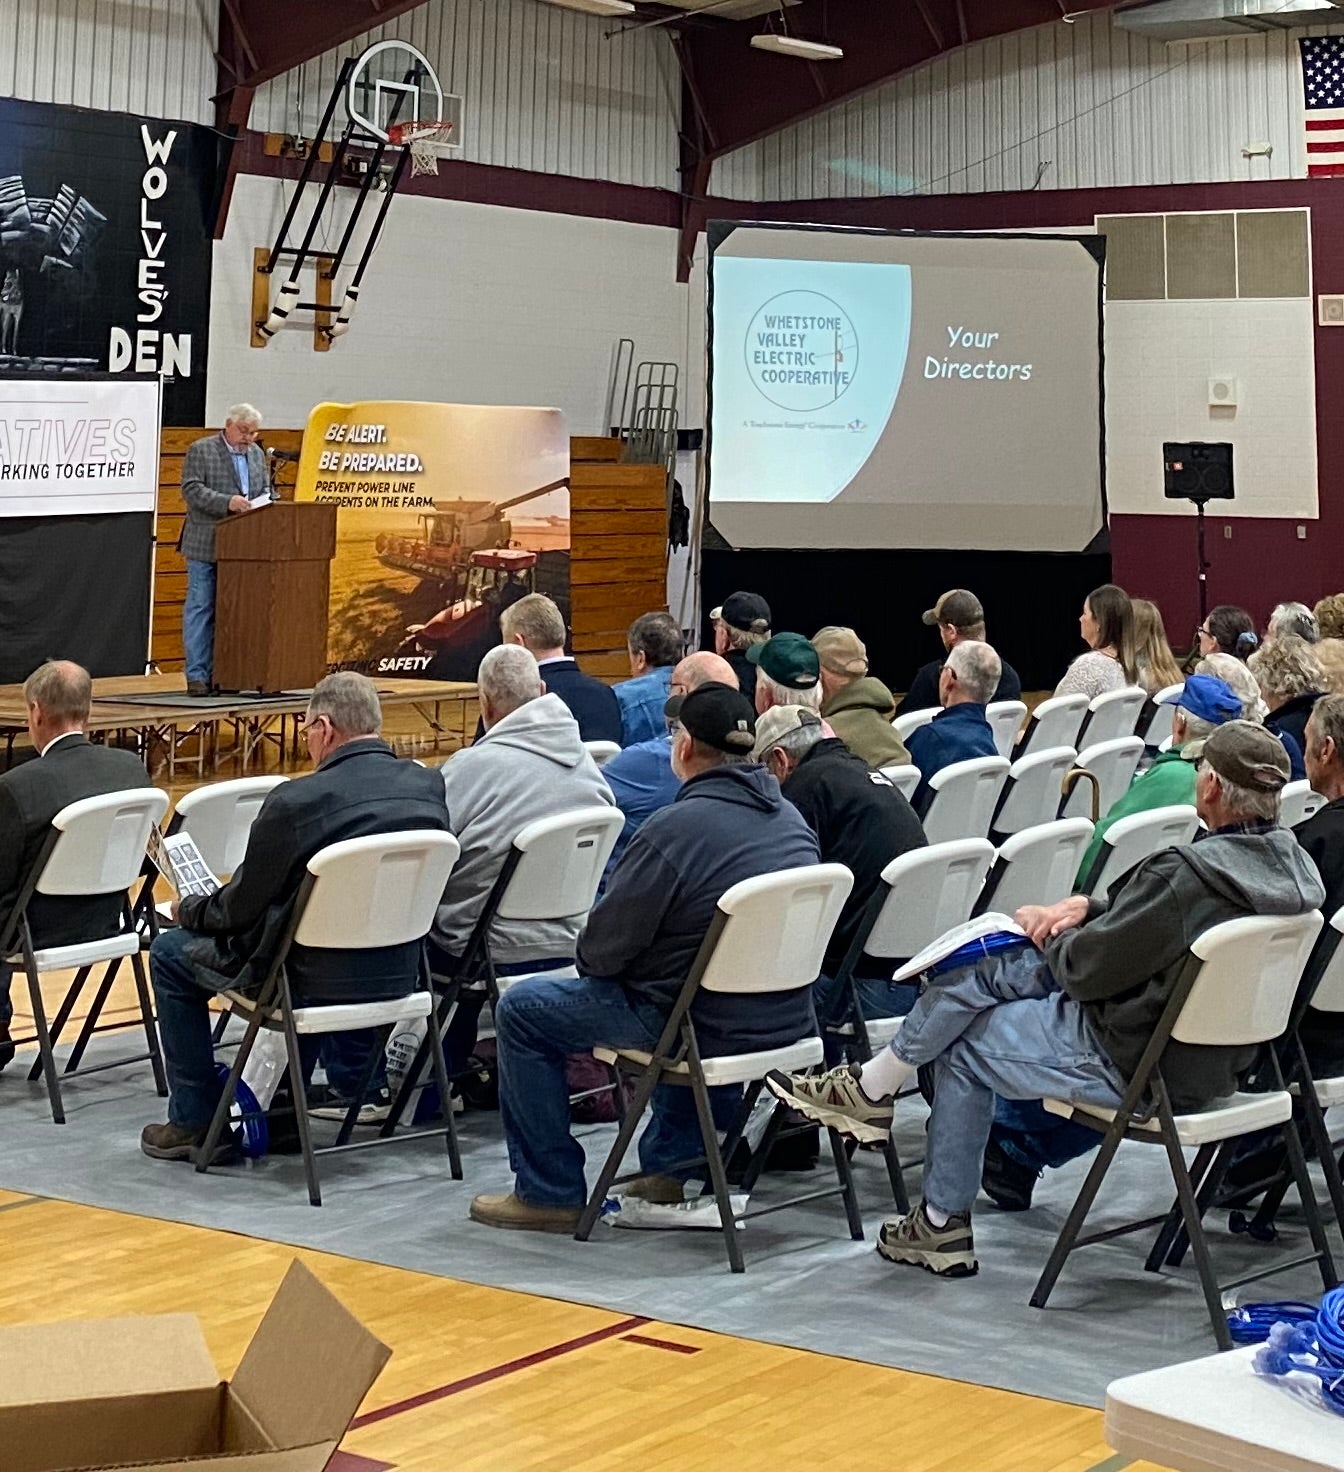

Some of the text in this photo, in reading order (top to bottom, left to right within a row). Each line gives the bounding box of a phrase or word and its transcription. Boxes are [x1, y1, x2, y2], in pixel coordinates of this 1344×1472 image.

[764, 315, 841, 330] WHETSTONE
[757, 333, 806, 348] VALLEY
[947, 326, 999, 350] Your
[109, 326, 191, 377] DEN
[754, 351, 816, 366] ELECTRIC
[924, 356, 1033, 381] Directors
[761, 369, 849, 385] COOPERATIVE
[325, 424, 387, 443] BE ALERT.
[318, 451, 423, 472] BE PREPARED.
[55, 461, 135, 479] TOGETHER
[315, 481, 415, 493] PREVENT POWER LINE
[365, 496, 380, 508] ON
[382, 496, 400, 508] THE
[401, 497, 435, 508] FARM.
[377, 656, 432, 672] SAFETY
